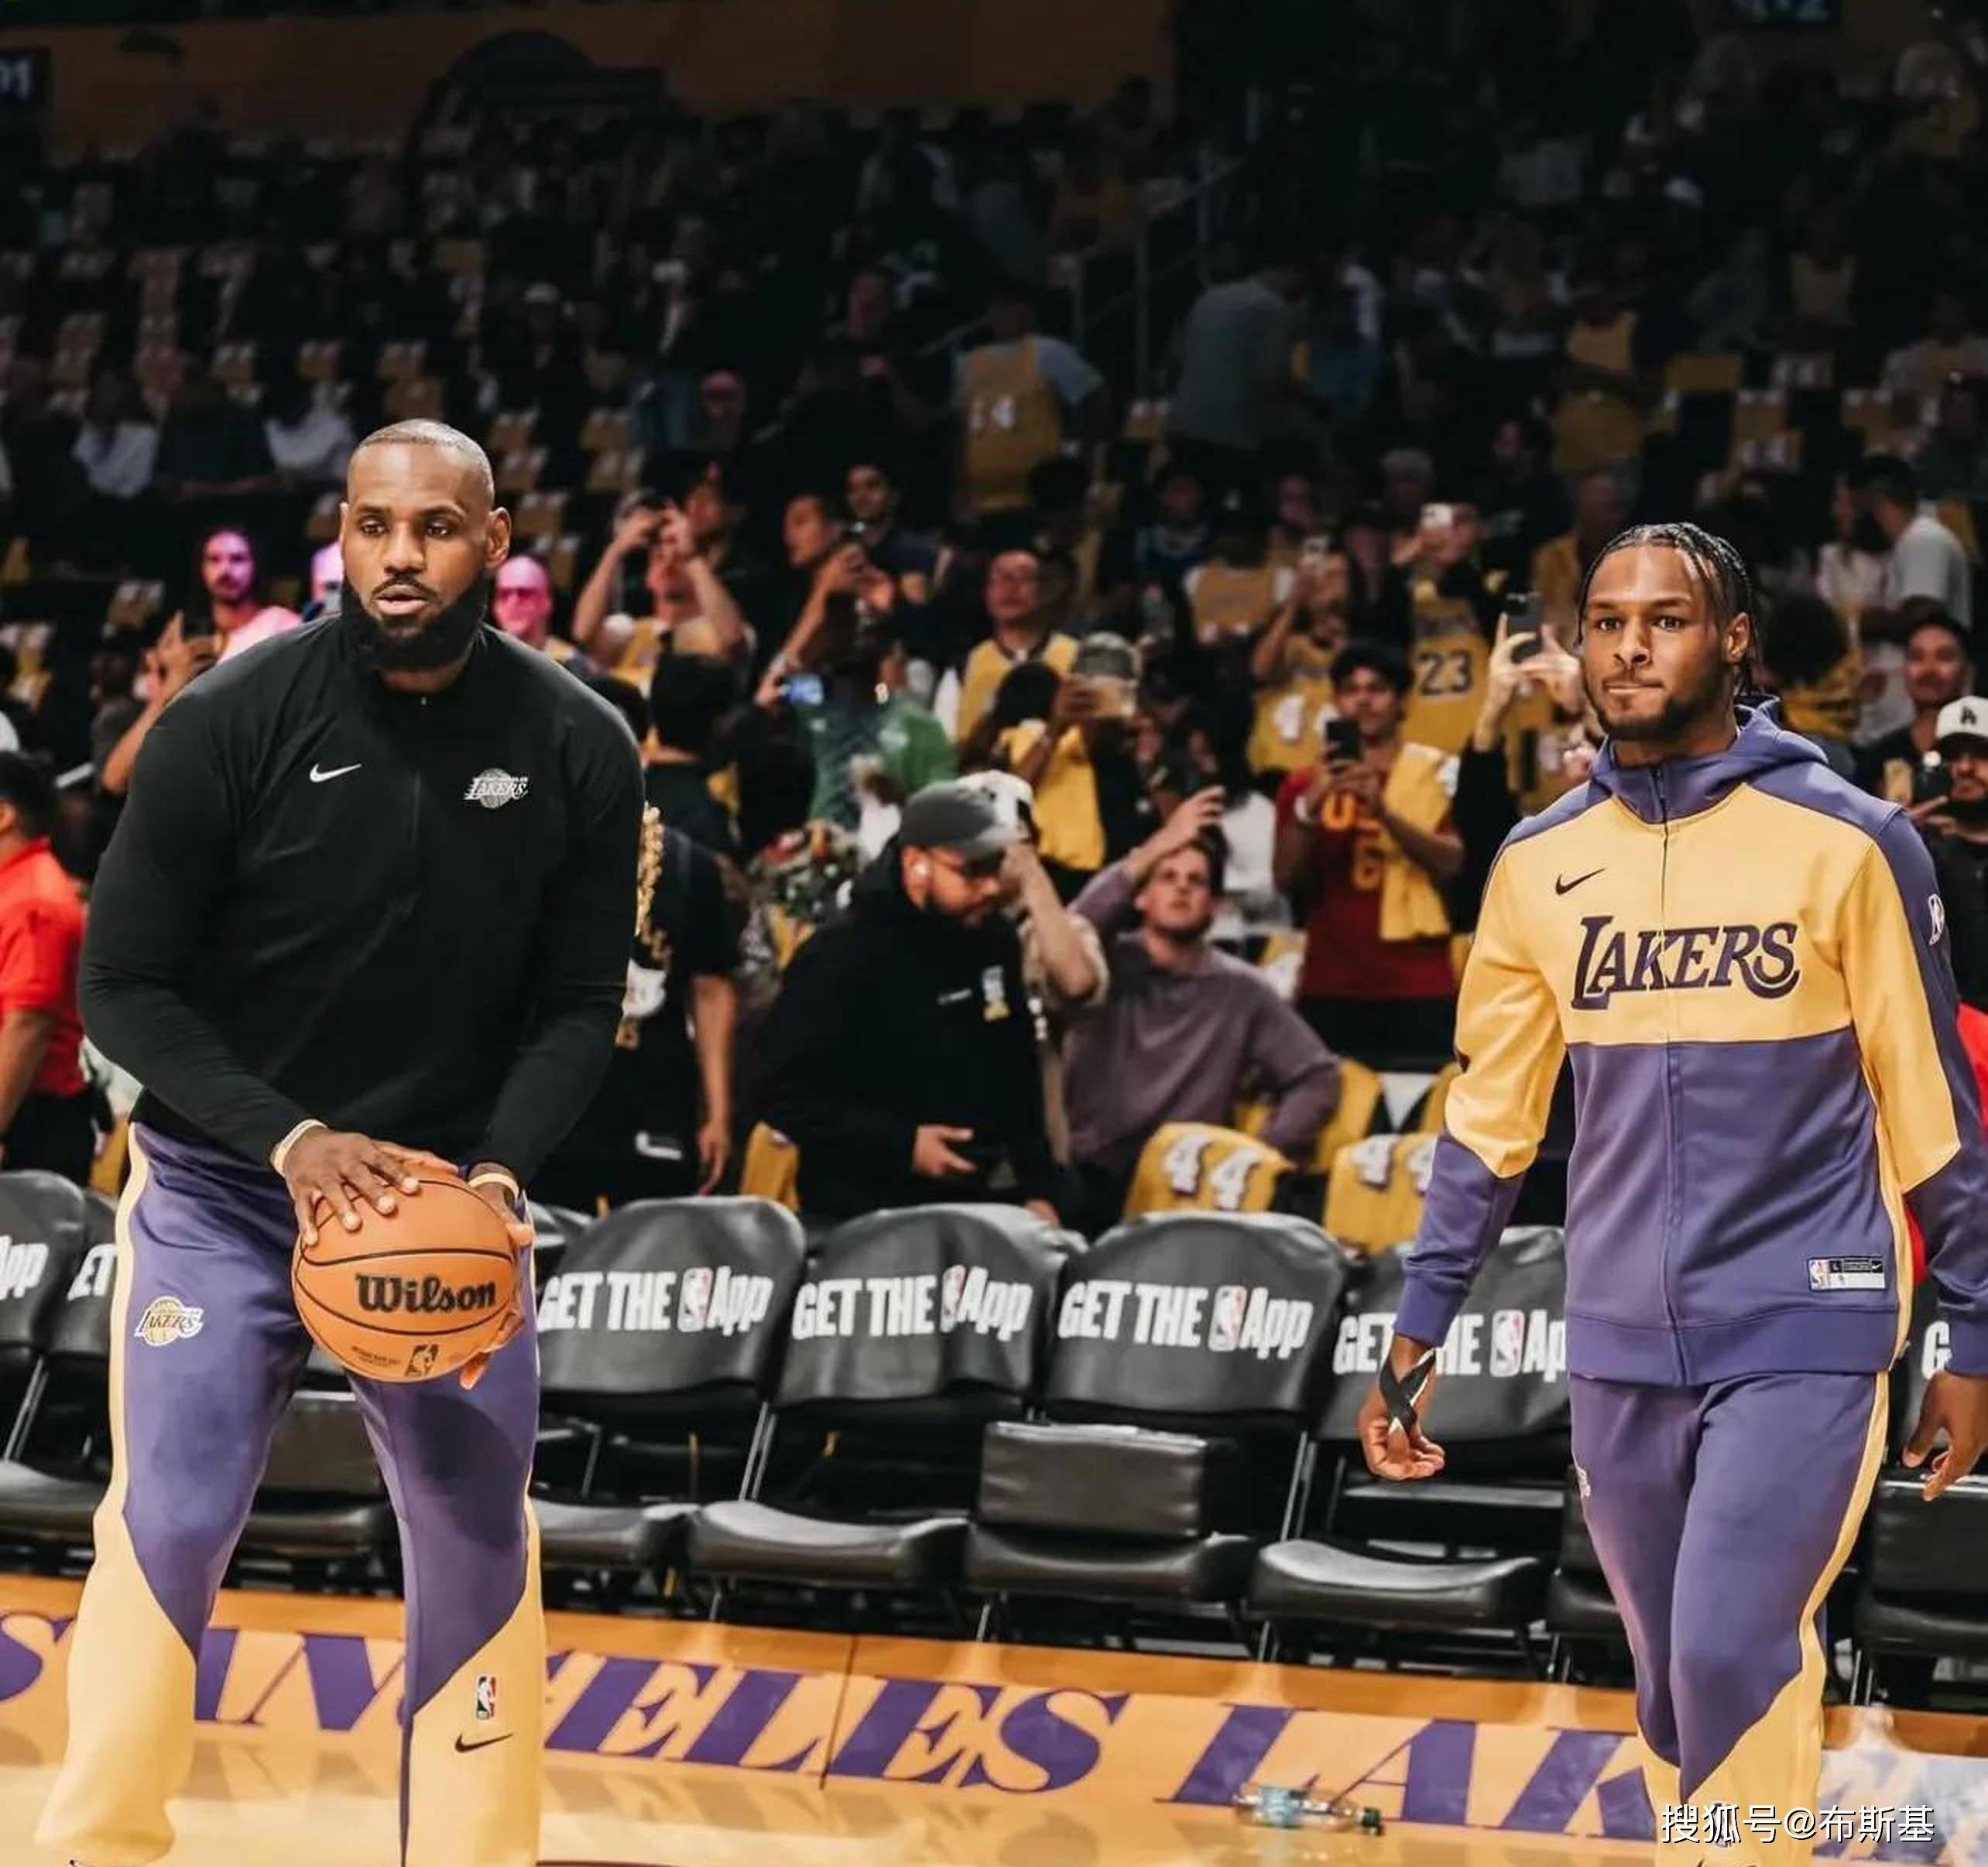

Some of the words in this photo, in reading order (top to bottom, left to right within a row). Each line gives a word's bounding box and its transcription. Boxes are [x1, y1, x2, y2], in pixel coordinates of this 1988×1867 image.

[1418, 651, 1474, 696] 23
[1572, 916, 1801, 1010] LAKERS
[355, 1273, 496, 1314] Wilson
[537, 1271, 604, 1333] GET
[606, 1271, 677, 1331] THE
[705, 1265, 773, 1337] App
[792, 1279, 862, 1340] GET
[866, 1275, 937, 1337] THE
[956, 1266, 1033, 1341] App
[1057, 1279, 1133, 1340] GET
[1133, 1283, 1209, 1348] THE
[1239, 1286, 1314, 1359] App
[1434, 1314, 1484, 1375] HE
[1523, 1309, 1567, 1382] Ap
